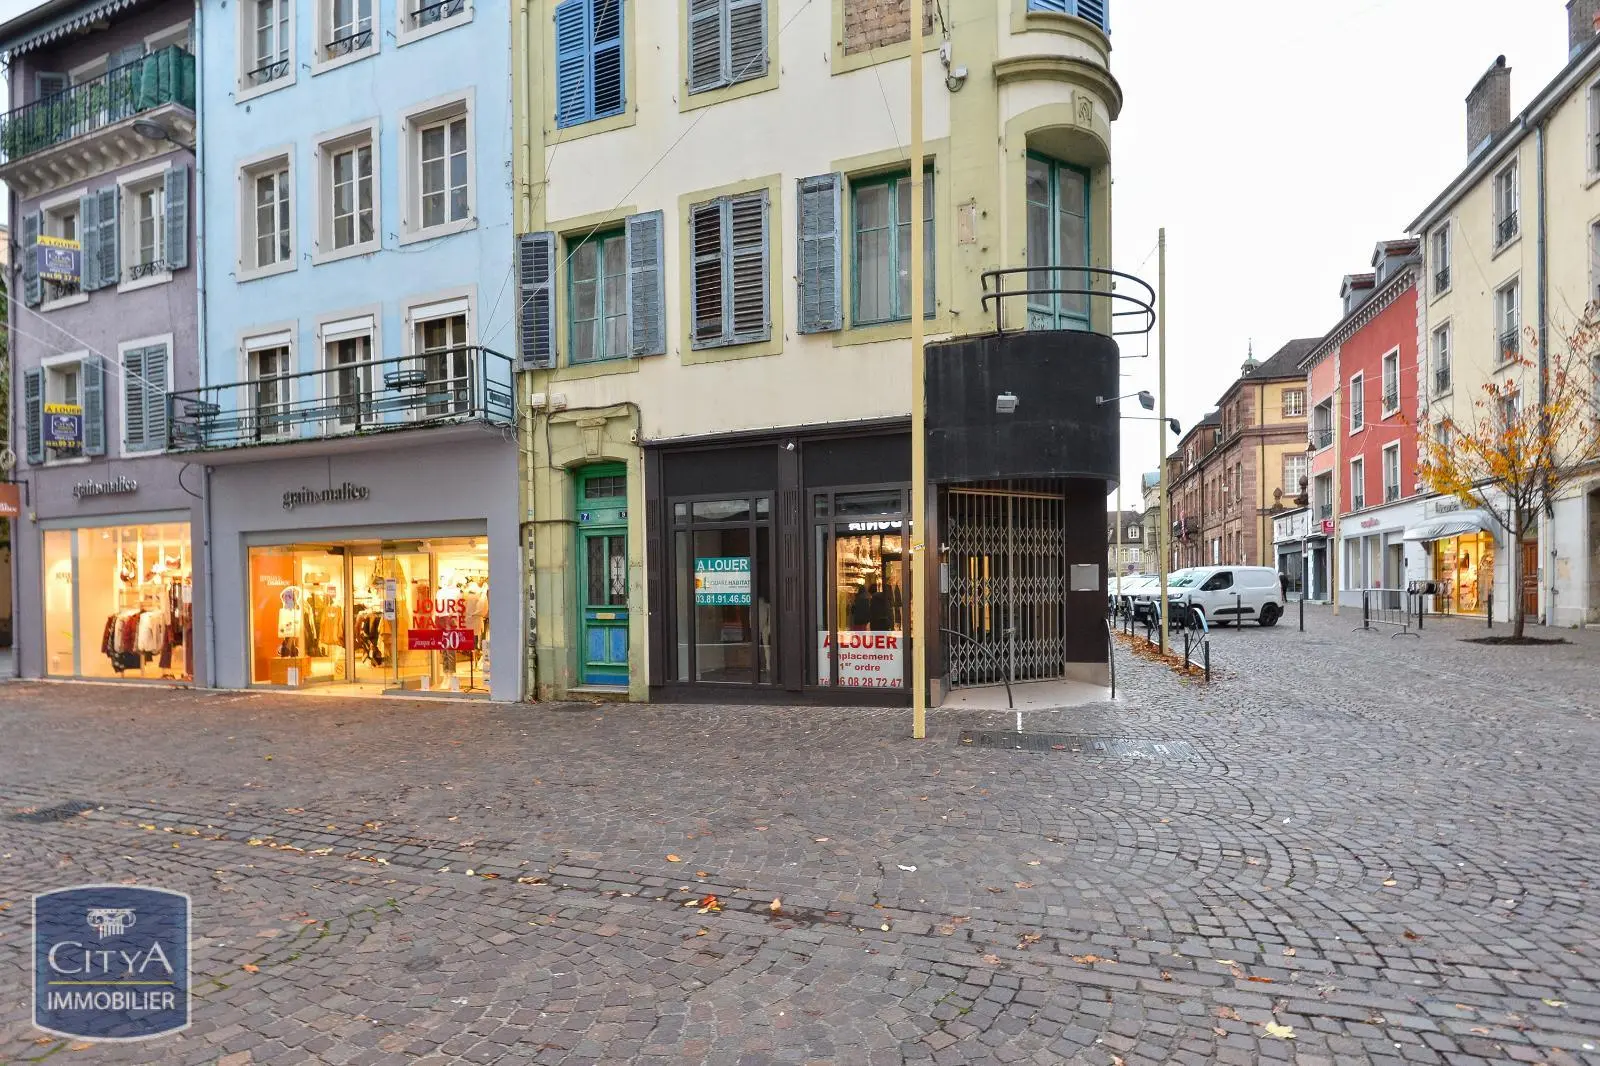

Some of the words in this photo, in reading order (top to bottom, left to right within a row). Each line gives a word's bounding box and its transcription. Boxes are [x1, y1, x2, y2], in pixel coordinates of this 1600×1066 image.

[697, 560, 705, 570] A
[709, 559, 748, 571] LOUER
[696, 594, 750, 604] 03.81.91.46.50
[413, 599, 466, 613] JOURS
[840, 635, 898, 650] LOUER
[855, 663, 880, 672] ordre
[848, 677, 859, 687] 08
[862, 678, 873, 688] 28
[876, 678, 887, 688] 72
[891, 679, 902, 688] 47
